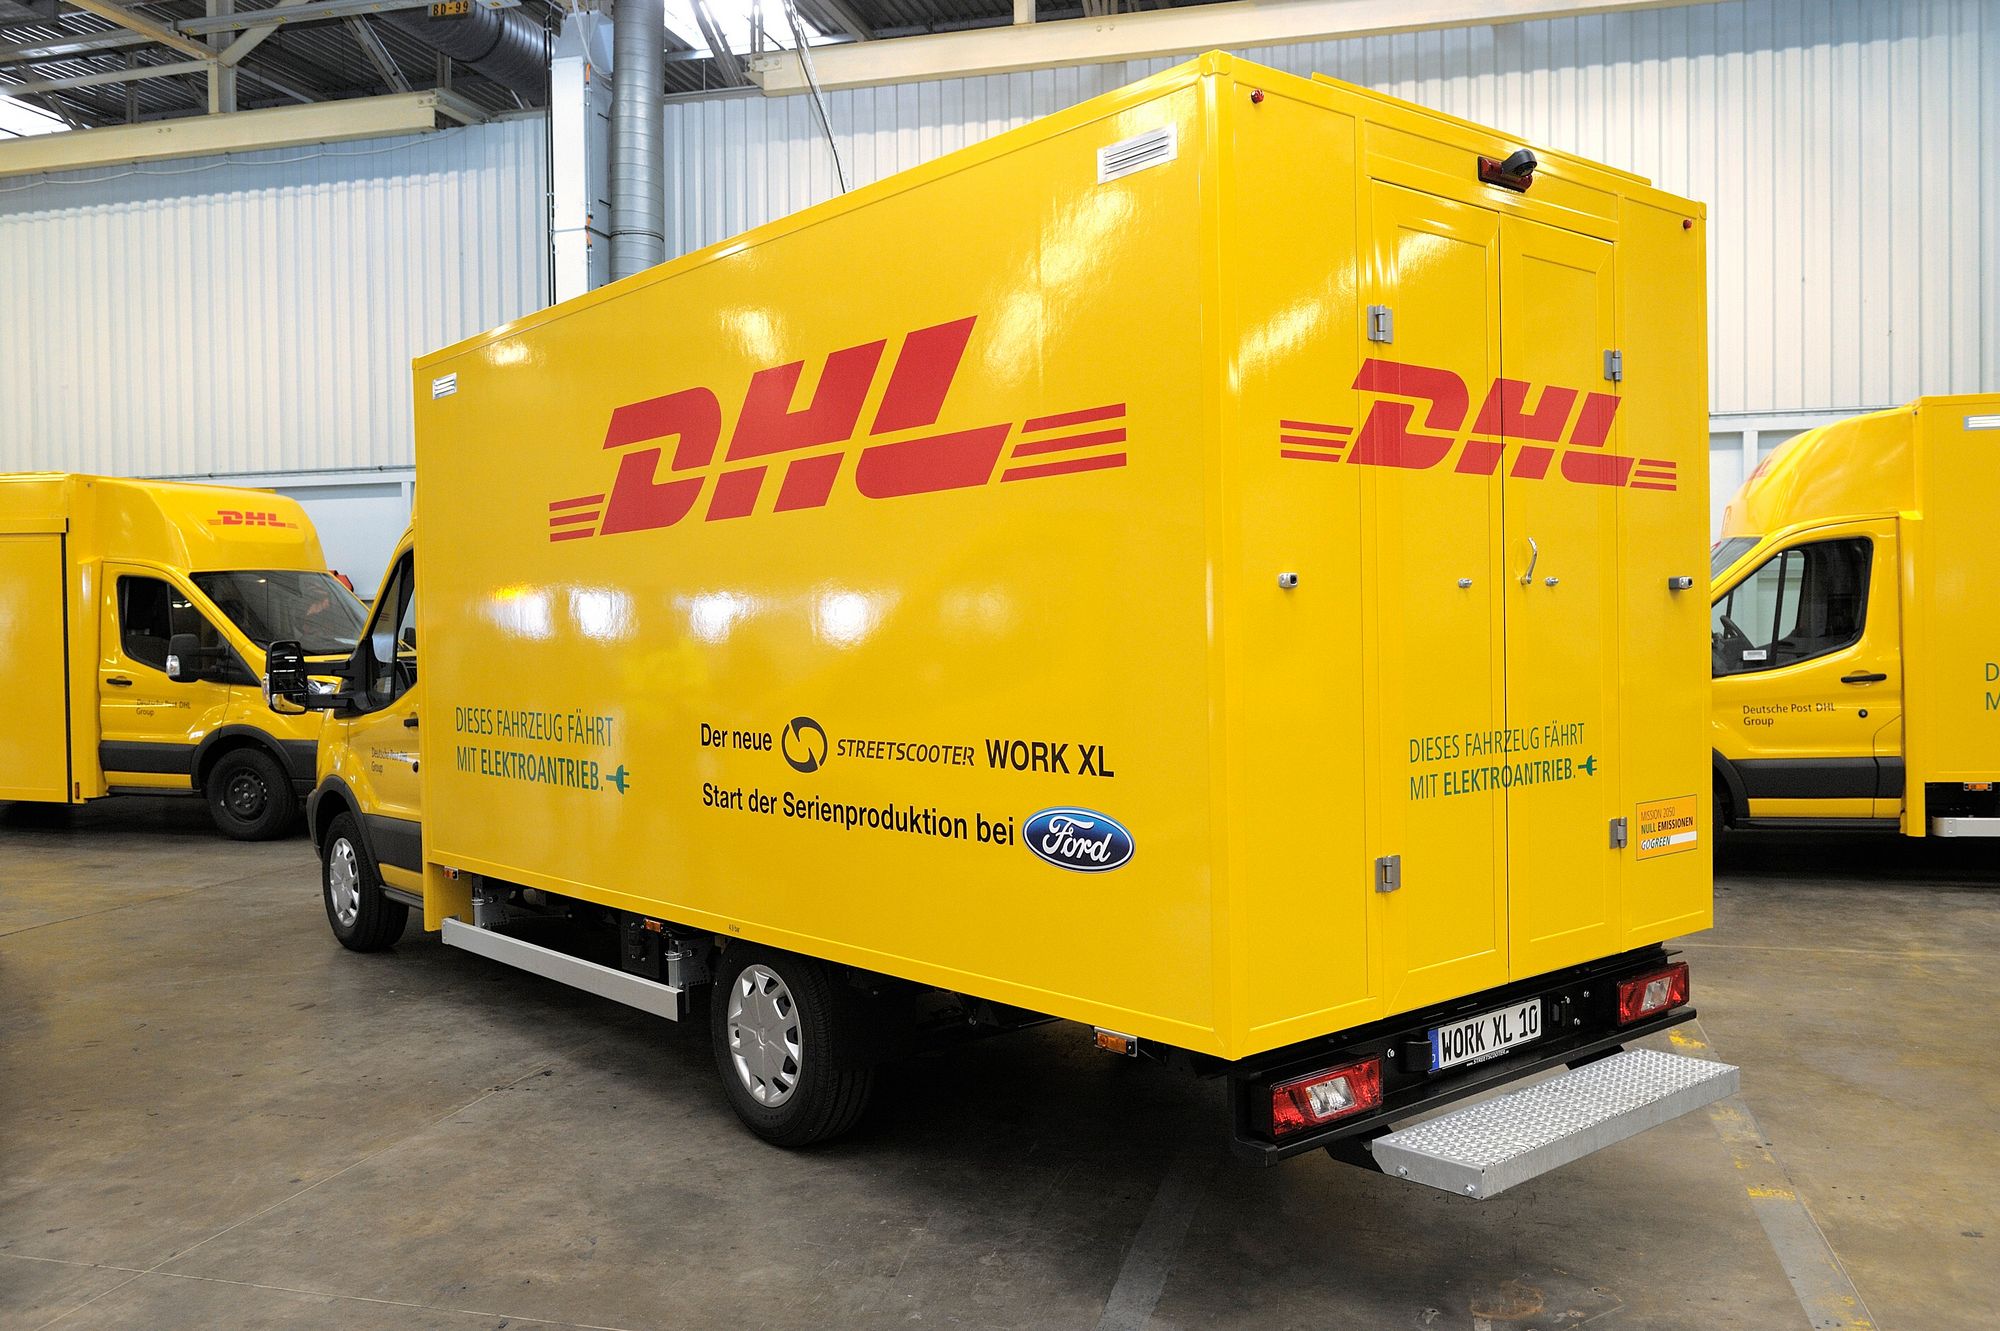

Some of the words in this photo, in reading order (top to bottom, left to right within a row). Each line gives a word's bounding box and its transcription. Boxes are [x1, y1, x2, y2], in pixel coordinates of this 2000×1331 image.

[594, 315, 1013, 536] DHL
[1345, 357, 1635, 488] DHL
[217, 510, 286, 528] DHL
[136, 708, 154, 716] Group
[456, 706, 492, 735] DIESES
[496, 709, 562, 742] FAHRZEUG
[568, 708, 614, 747] FÄHRT
[1743, 704, 1788, 714] Deutsche
[1791, 704, 1812, 712] Post
[1816, 702, 1836, 712] DHL
[1743, 716, 1774, 727] Group
[700, 722, 728, 748] Der
[732, 730, 772, 752] neue
[836, 738, 975, 766] STREETSCOOTER
[985, 738, 1070, 774] WORK
[1078, 744, 1114, 778] XL
[1410, 734, 1460, 764] DIESES
[1465, 726, 1540, 757] FAHRZEUG
[1544, 720, 1585, 748] FÄHRT
[456, 745, 477, 773] MIT
[480, 748, 604, 792] ELEKTROANTRIEB.
[1410, 773, 1438, 800] MIT
[1444, 758, 1576, 796] ELEKTROANTRIEB.
[702, 782, 743, 811] Start
[748, 788, 778, 815] der
[782, 791, 968, 840] Serienproduktion
[976, 813, 1014, 846] bei
[1042, 815, 1112, 862] Ford
[1640, 808, 1662, 821] MISSION
[1663, 806, 1676, 818] 2050
[1640, 822, 1656, 834] NULL
[1658, 816, 1694, 832] EMISSIONEN
[1641, 836, 1671, 850] GOGREEN
[1442, 1020, 1486, 1062] WORK
[1492, 1014, 1513, 1047] XL
[1518, 1004, 1538, 1038] 10
